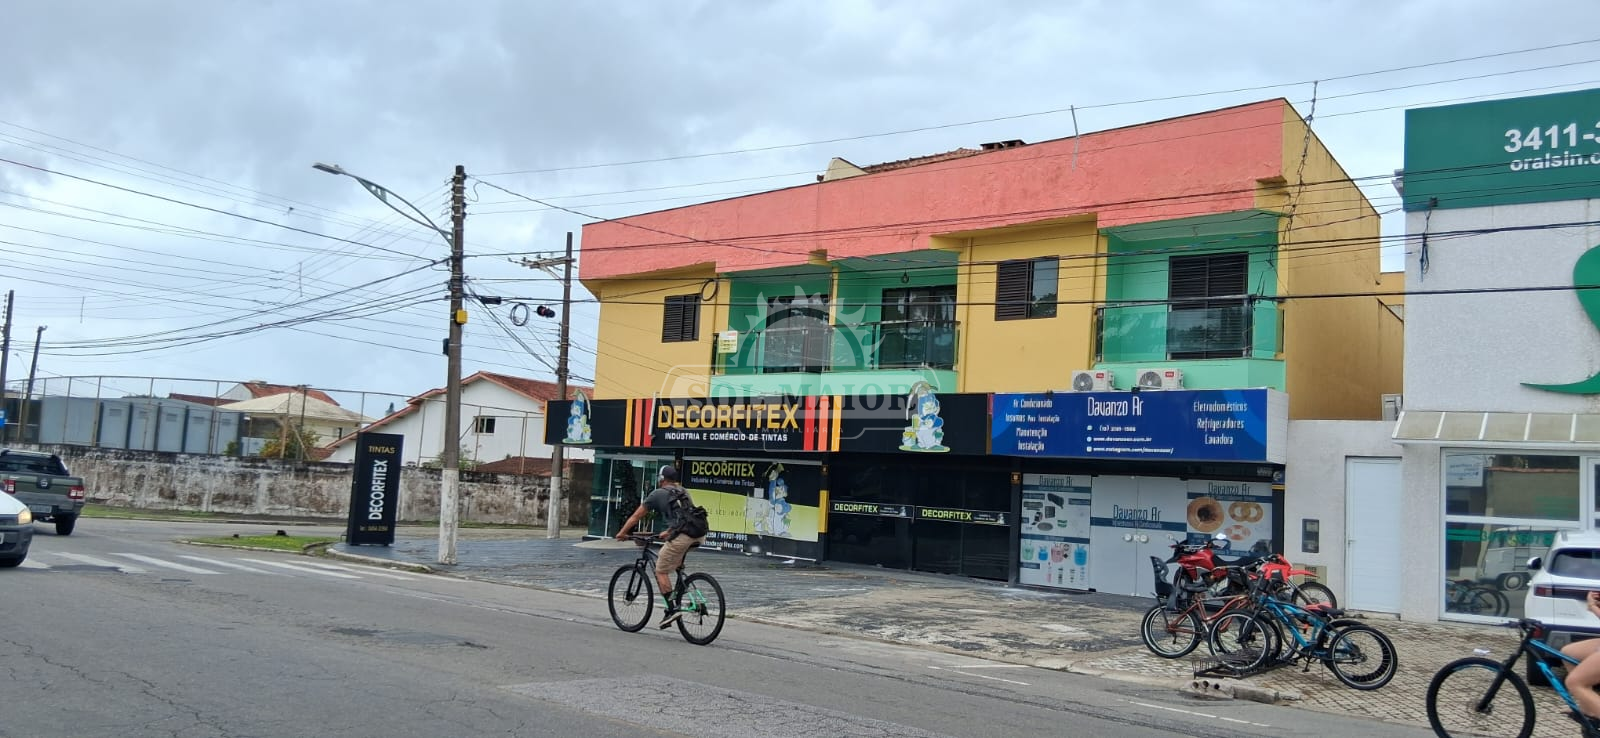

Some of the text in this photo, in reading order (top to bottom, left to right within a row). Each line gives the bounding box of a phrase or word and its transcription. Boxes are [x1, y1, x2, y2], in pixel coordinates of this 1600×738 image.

[1088, 395, 1144, 416] Davanzo Ar
[657, 403, 799, 429] DECORFITEX
[1197, 417, 1245, 431] Refrigeradores
[665, 431, 788, 442] INDÚSTRIA E COMÉRCIO DE TINTAS
[1016, 427, 1048, 439] Manutenção
[1205, 433, 1234, 445] Lavadora
[368, 445, 396, 454] TINTAS
[691, 461, 755, 478] DECORFITEX
[368, 460, 388, 520] DECORFITEX
[834, 503, 878, 513] DECORFITEX
[921, 508, 972, 521] DECORFITEX
[1113, 504, 1161, 521] Davanzo Ar
